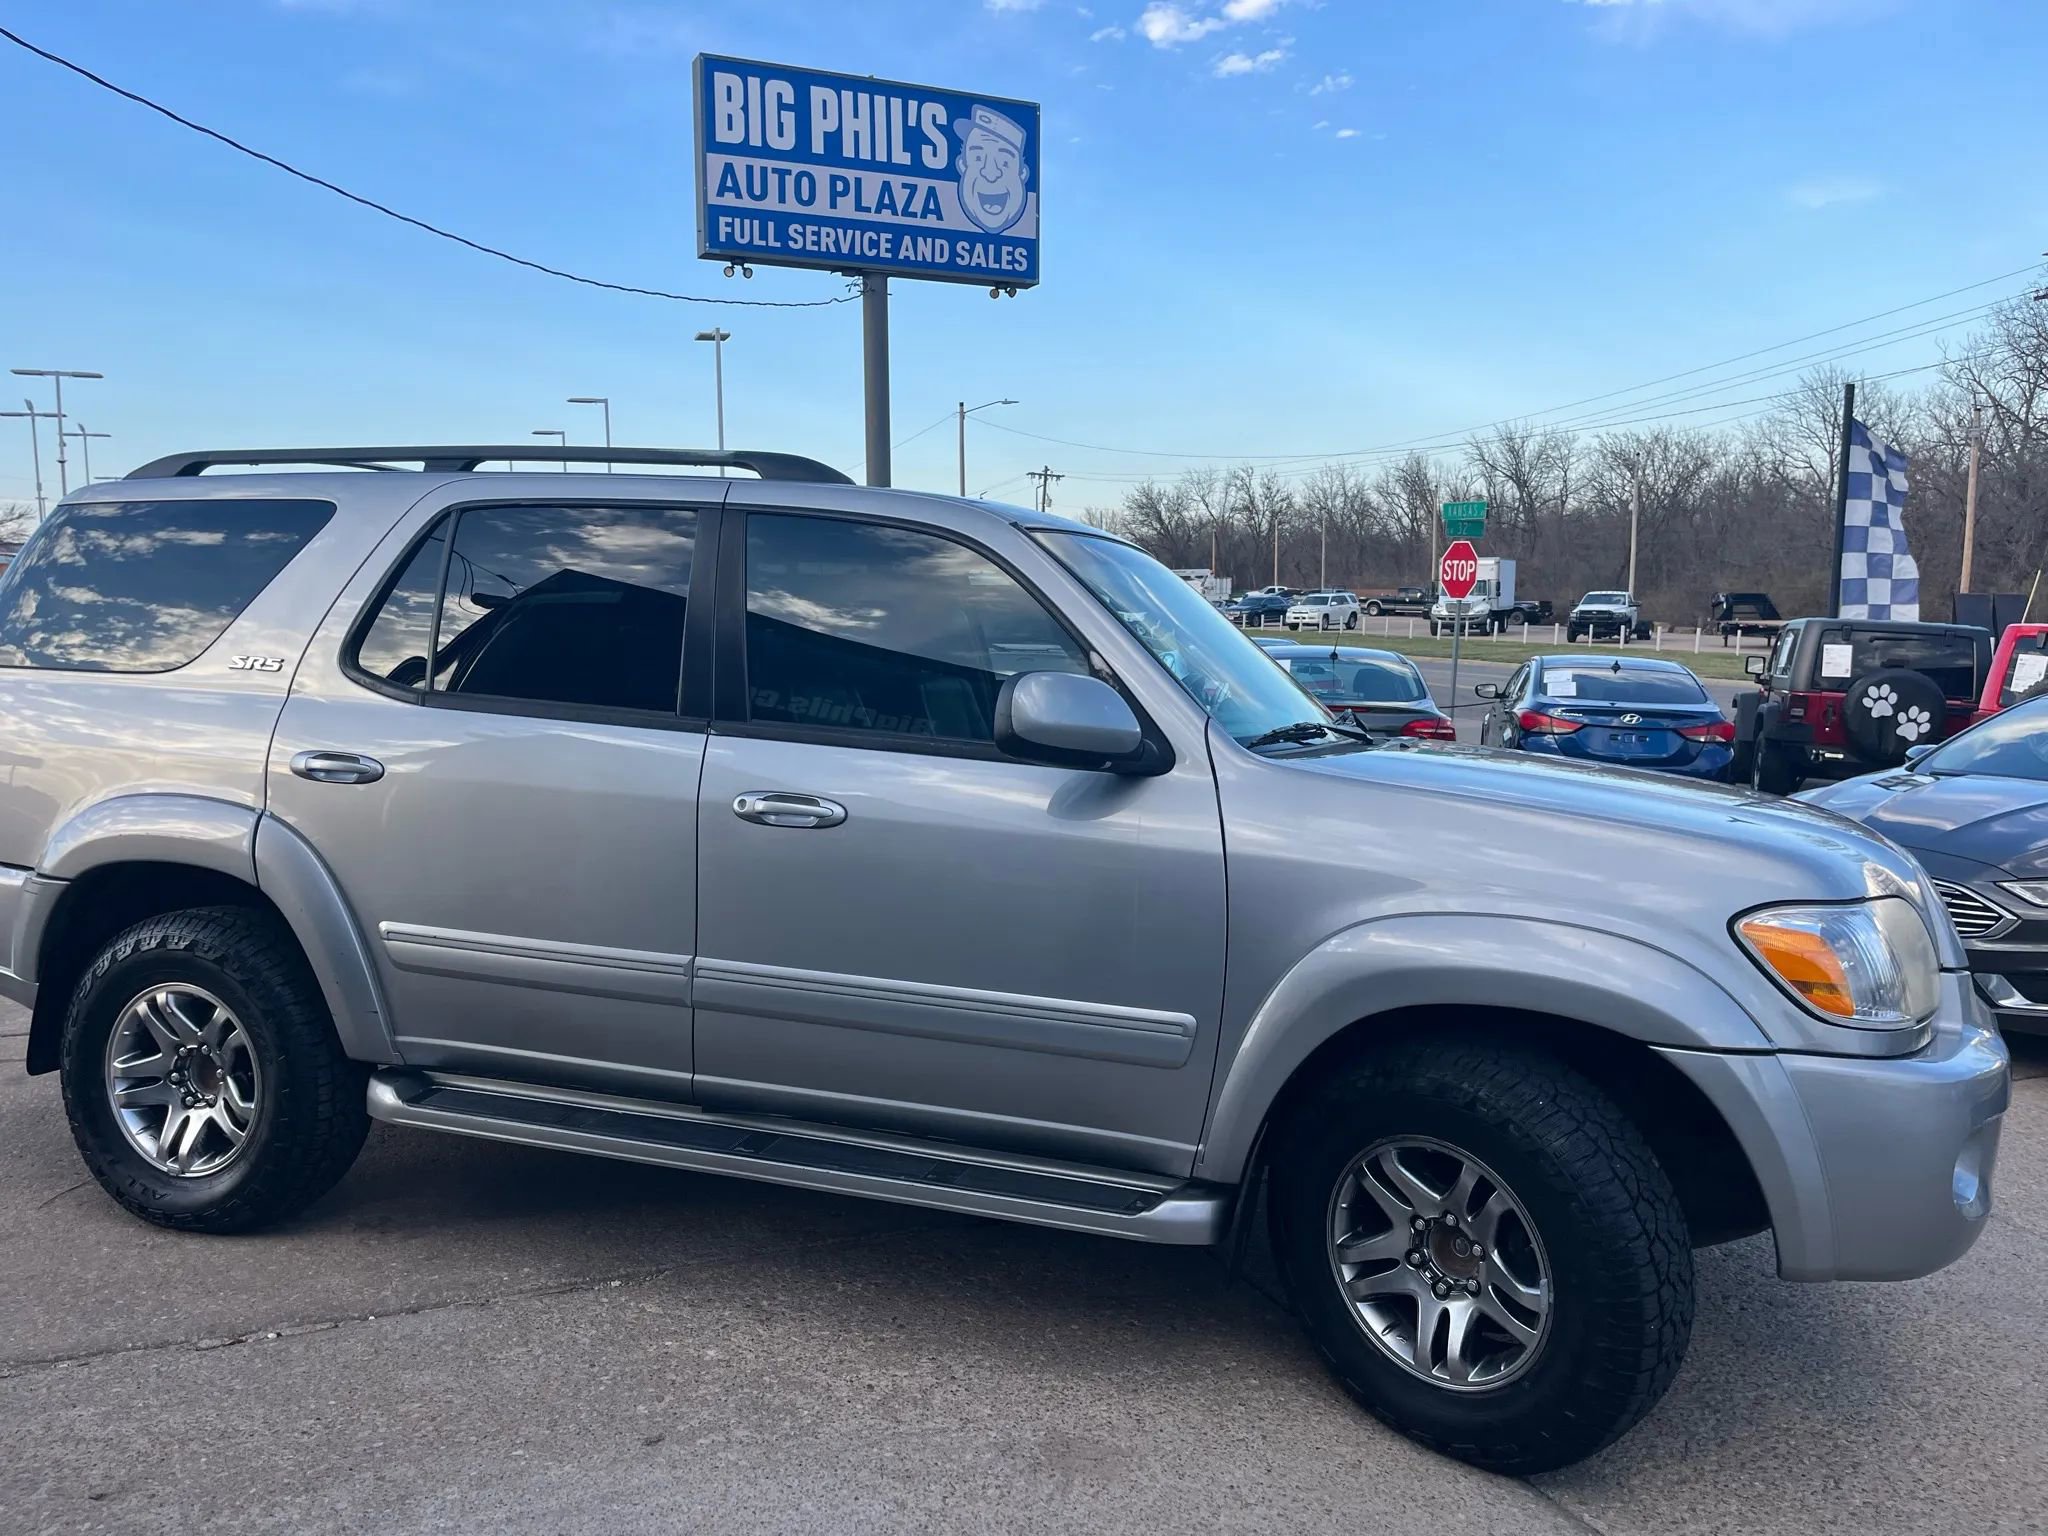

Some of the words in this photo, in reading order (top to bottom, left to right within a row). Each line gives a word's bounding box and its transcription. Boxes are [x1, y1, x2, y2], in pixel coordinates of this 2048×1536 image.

[713, 71, 796, 150] BIG
[810, 85, 948, 169] PHIL'S
[715, 161, 816, 207] AUTO
[829, 174, 944, 222] PLAZA
[718, 216, 781, 247] FULL
[788, 223, 892, 258] SERVICE
[898, 235, 949, 264] AND
[955, 241, 1028, 272] SALES
[1443, 560, 1476, 581] STOP
[228, 655, 285, 672] SR5
